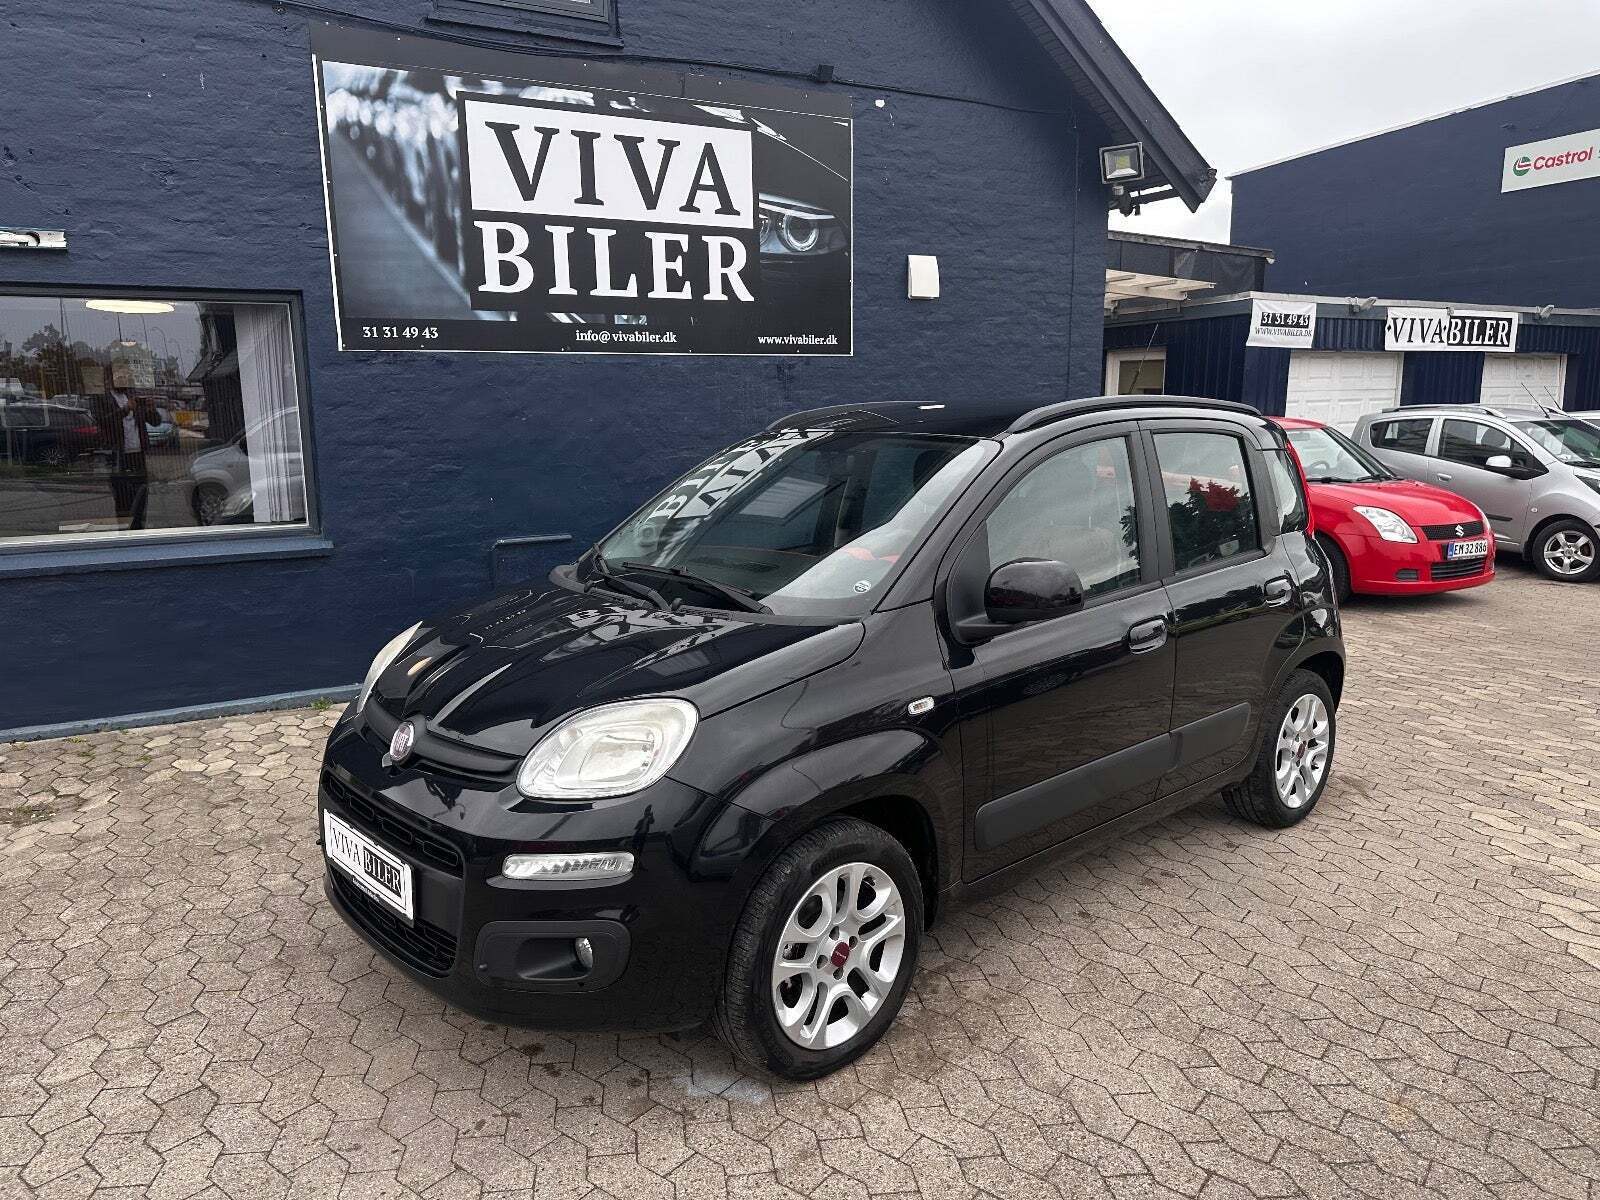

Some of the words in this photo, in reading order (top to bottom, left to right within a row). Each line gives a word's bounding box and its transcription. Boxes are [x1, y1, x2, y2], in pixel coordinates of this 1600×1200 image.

[485, 121, 741, 217] VIVA
[1533, 146, 1594, 170] Castrol
[473, 220, 755, 302] BILER
[1262, 312, 1273, 324] 31
[1275, 313, 1285, 325] 31
[1287, 314, 1298, 326] 49
[1299, 314, 1309, 326] 43
[1391, 317, 1446, 344] VIVA
[1448, 318, 1509, 345] BILER
[362, 326, 379, 339] 31
[383, 326, 399, 339] 31
[402, 327, 419, 339] 49
[422, 327, 439, 339] 43
[758, 334, 839, 346] www.vivabiler.dk
[332, 827, 362, 866] VIVA
[363, 849, 402, 894] BILER
